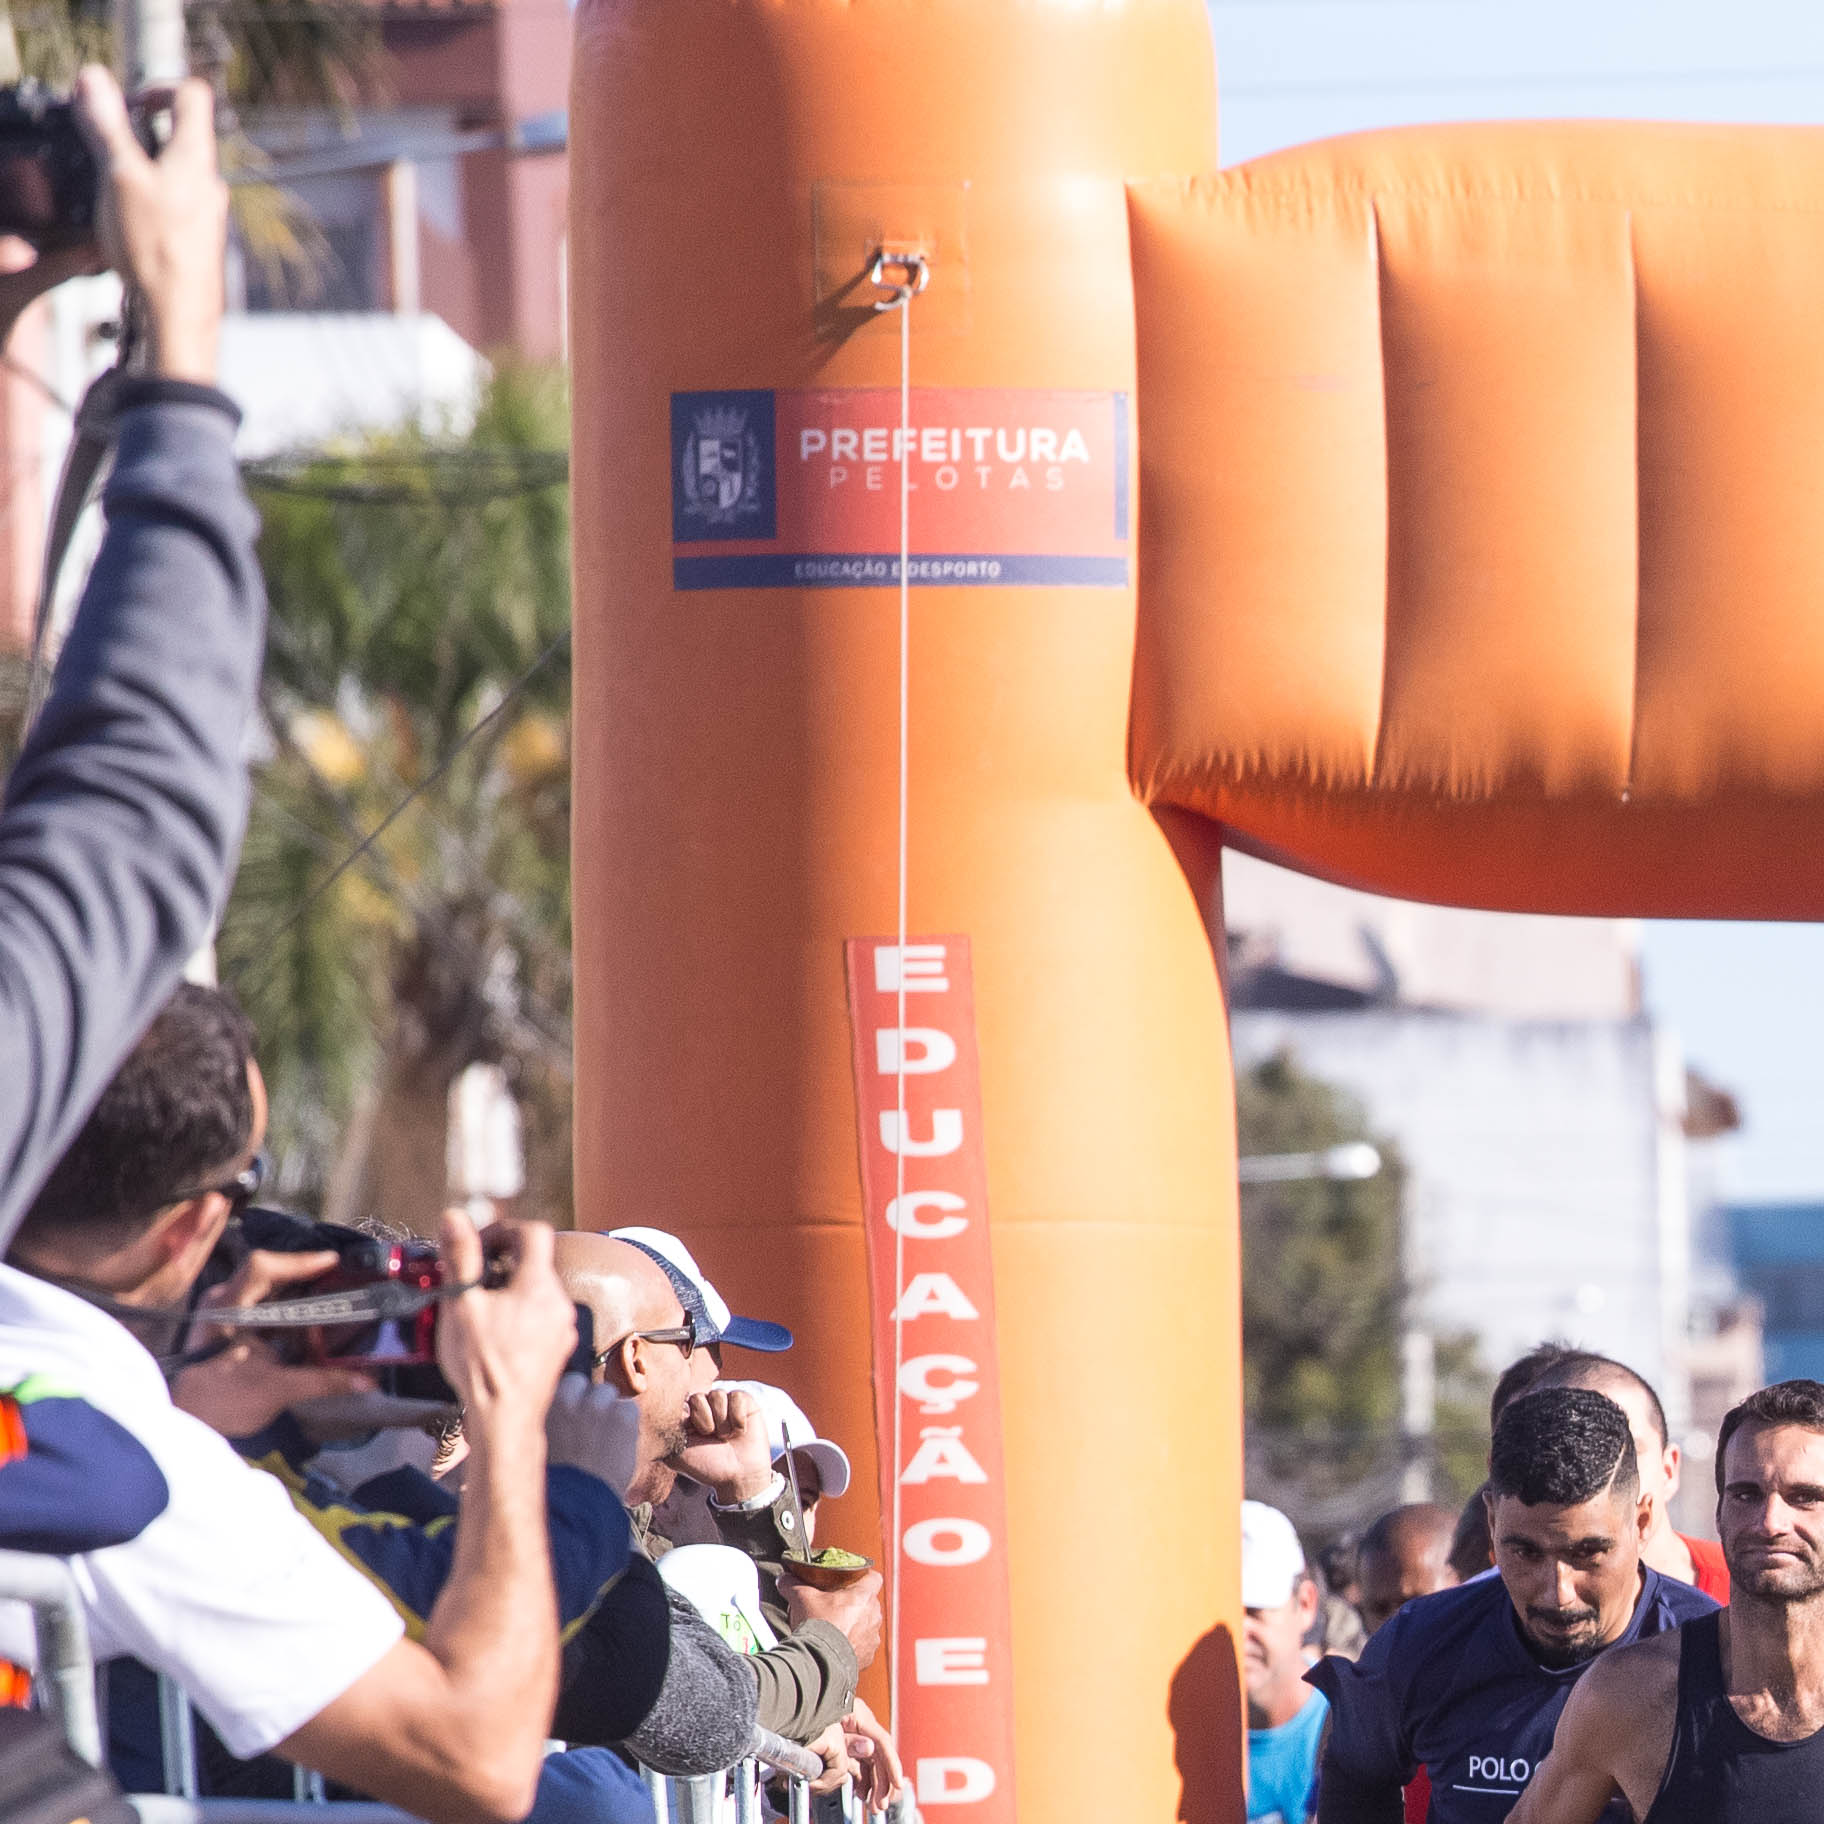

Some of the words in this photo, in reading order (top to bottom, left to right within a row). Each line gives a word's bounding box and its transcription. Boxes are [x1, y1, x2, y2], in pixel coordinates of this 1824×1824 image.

[800, 427, 1090, 463] PREFEITURA
[830, 464, 1067, 491] PELOTAS
[794, 559, 887, 579] EDUCAÇÃO
[907, 560, 1002, 579] DESPORTO
[873, 944, 992, 1567] EDUCAÇÃO
[914, 1636, 990, 1686] E
[1468, 1755, 1530, 1782] POLO
